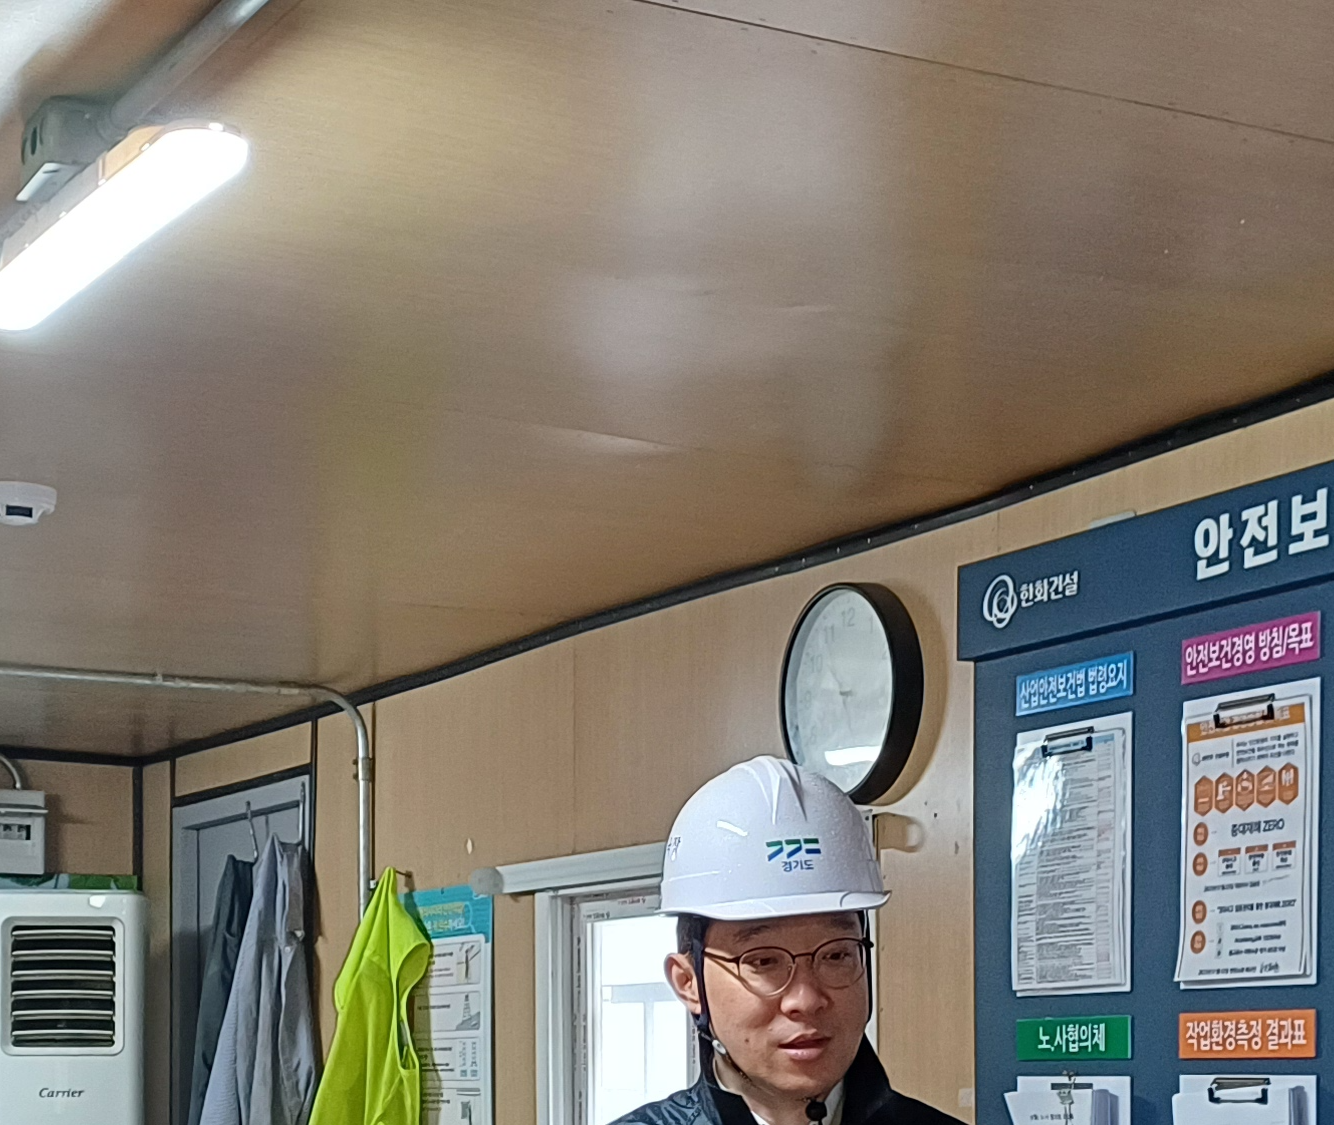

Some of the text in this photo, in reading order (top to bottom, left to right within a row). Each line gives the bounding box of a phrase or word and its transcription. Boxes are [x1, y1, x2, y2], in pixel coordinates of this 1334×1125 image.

[1020, 570, 1079, 608] 한화건설
[1185, 621, 1314, 676] 안전보건경영 방침/목표
[1020, 659, 1127, 709] 산업안전보건법 법령요지
[781, 859, 815, 872] 경기도
[1186, 1018, 1307, 1051] 작업환경측정 결과표
[38, 1086, 85, 1099] Carrier
